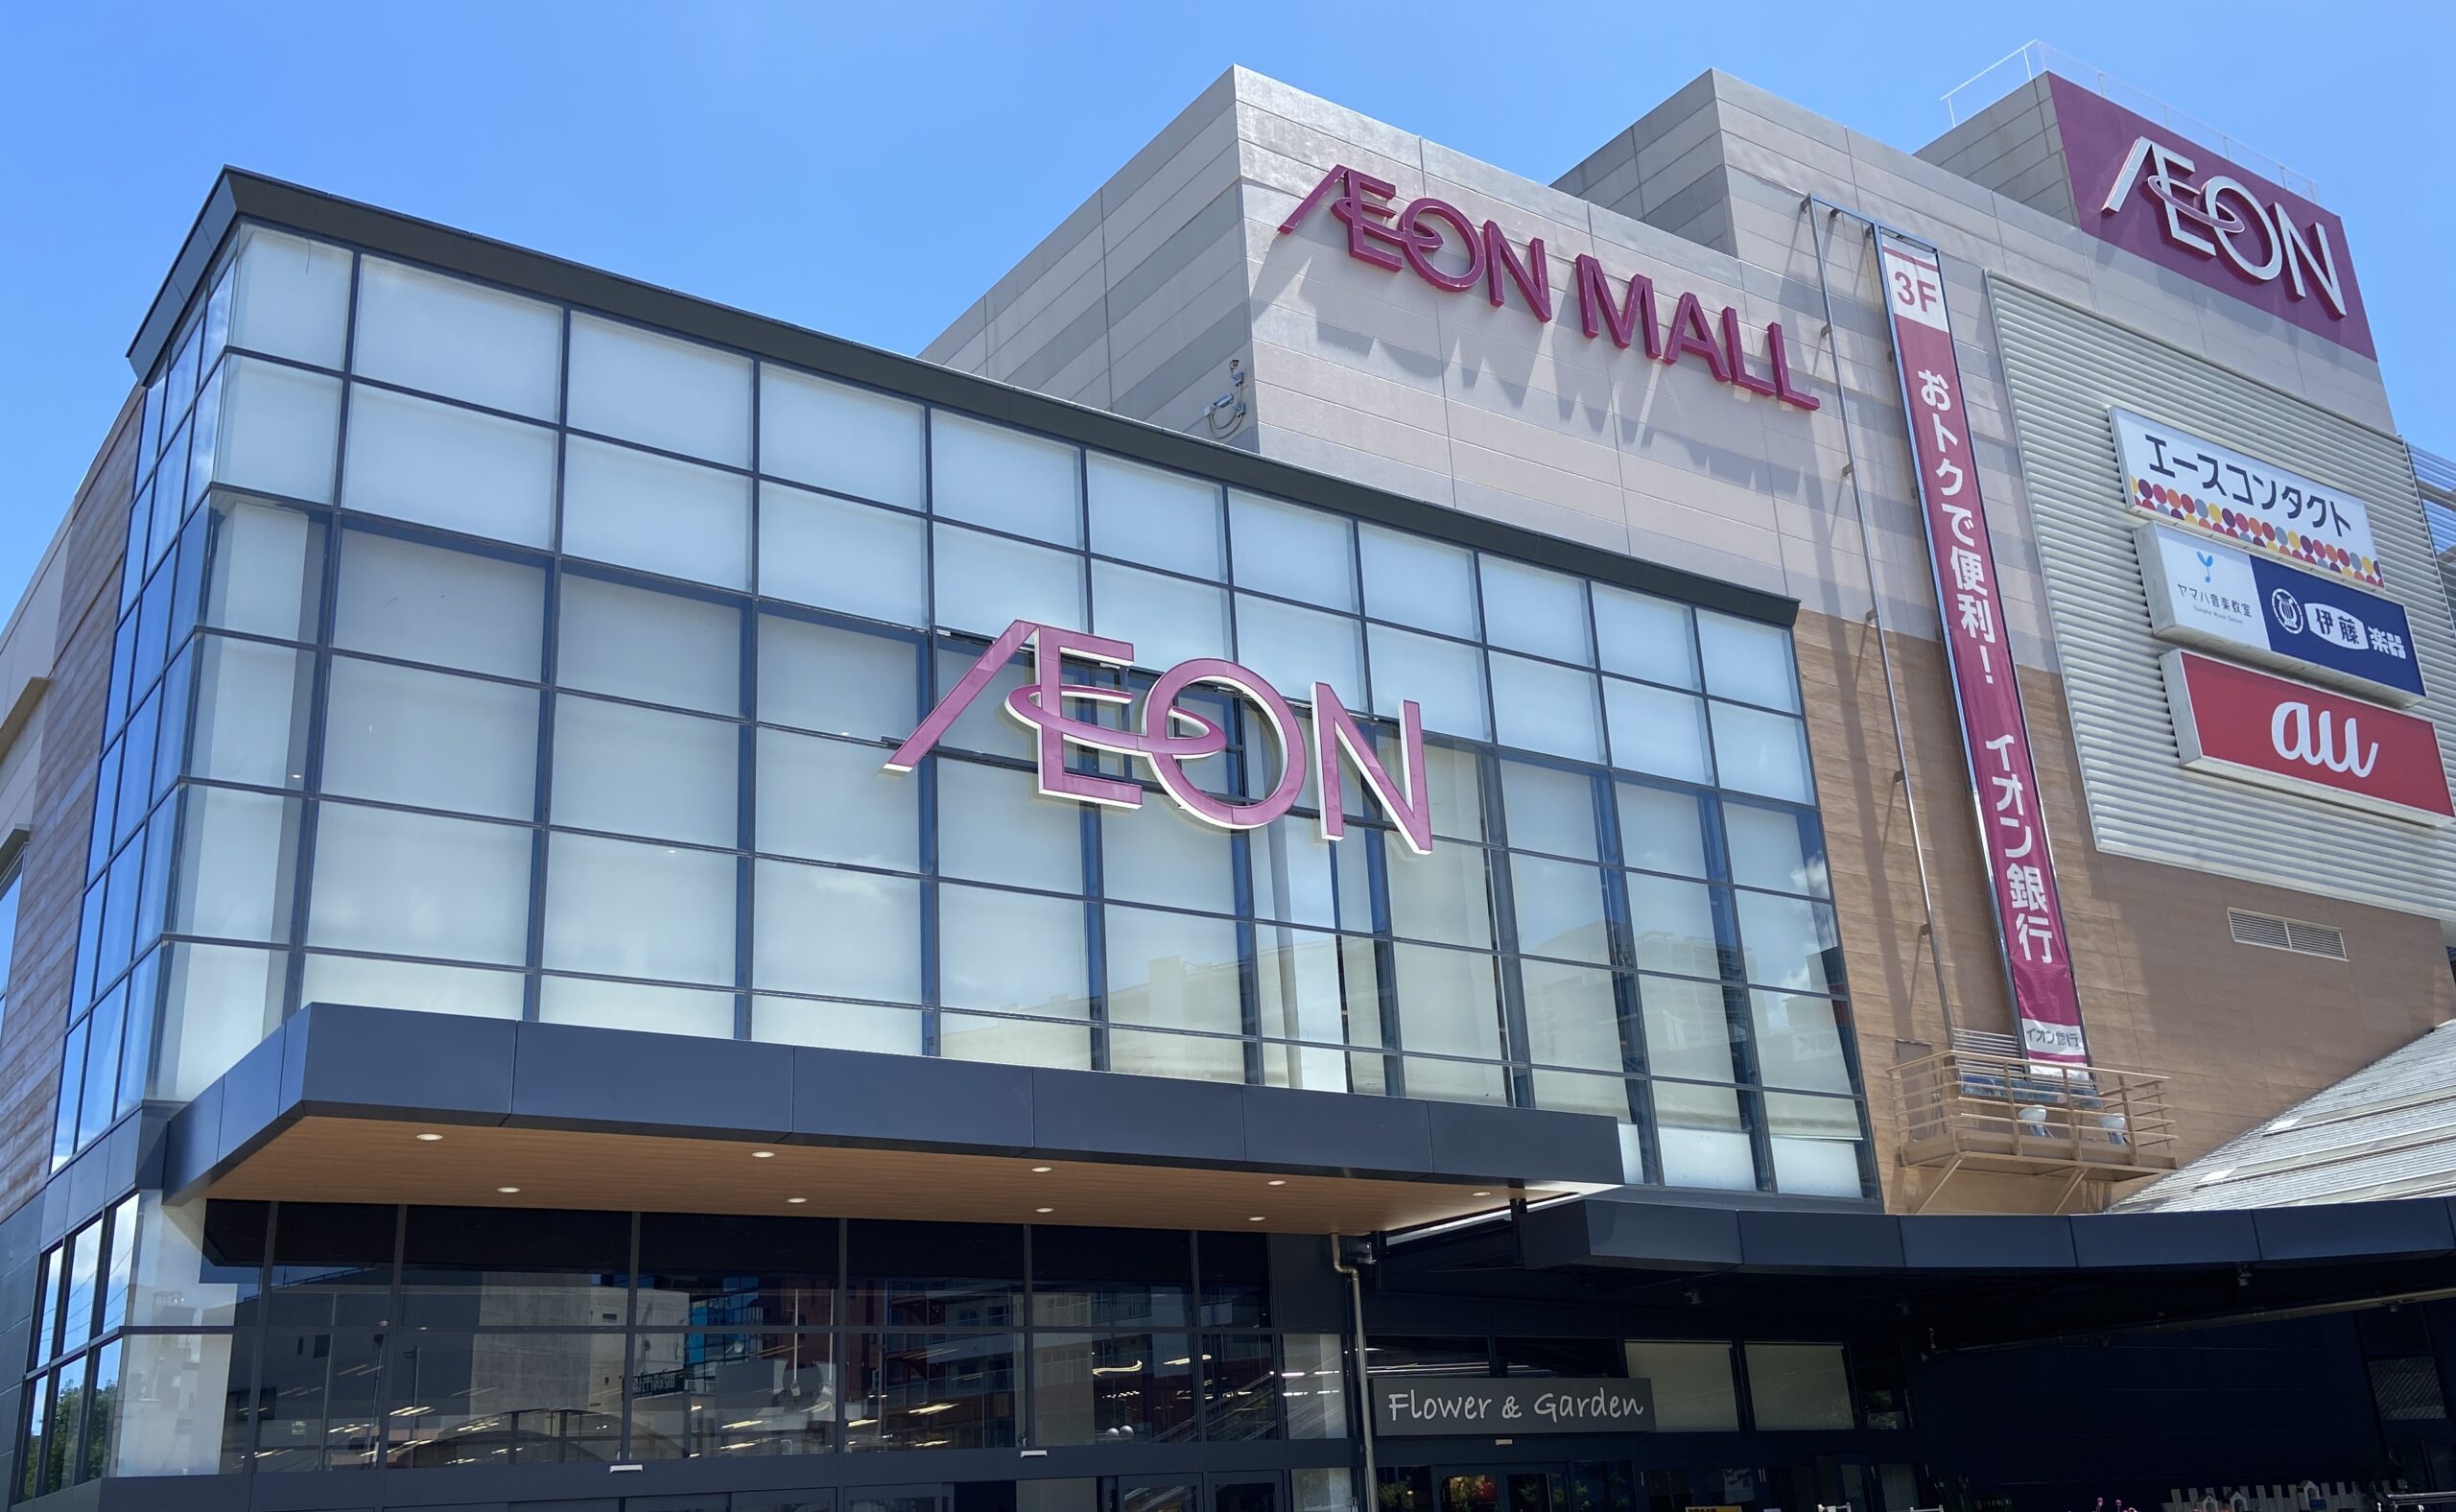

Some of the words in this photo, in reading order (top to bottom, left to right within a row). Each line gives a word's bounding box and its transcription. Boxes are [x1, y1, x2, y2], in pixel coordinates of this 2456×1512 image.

[1894, 271, 1937, 313] 3F
[1576, 253, 1820, 411] MALL
[2145, 435, 2351, 538] エースコンタクト
[2177, 582, 2253, 618] ヤマハ音楽教室
[2271, 700, 2378, 778] au
[1986, 734, 2053, 964] イオン銀行
[2027, 1028, 2080, 1048] イオン銀行
[1388, 1387, 1493, 1421] Flower
[1501, 1394, 1523, 1419] &
[1533, 1386, 1644, 1424] Garden
